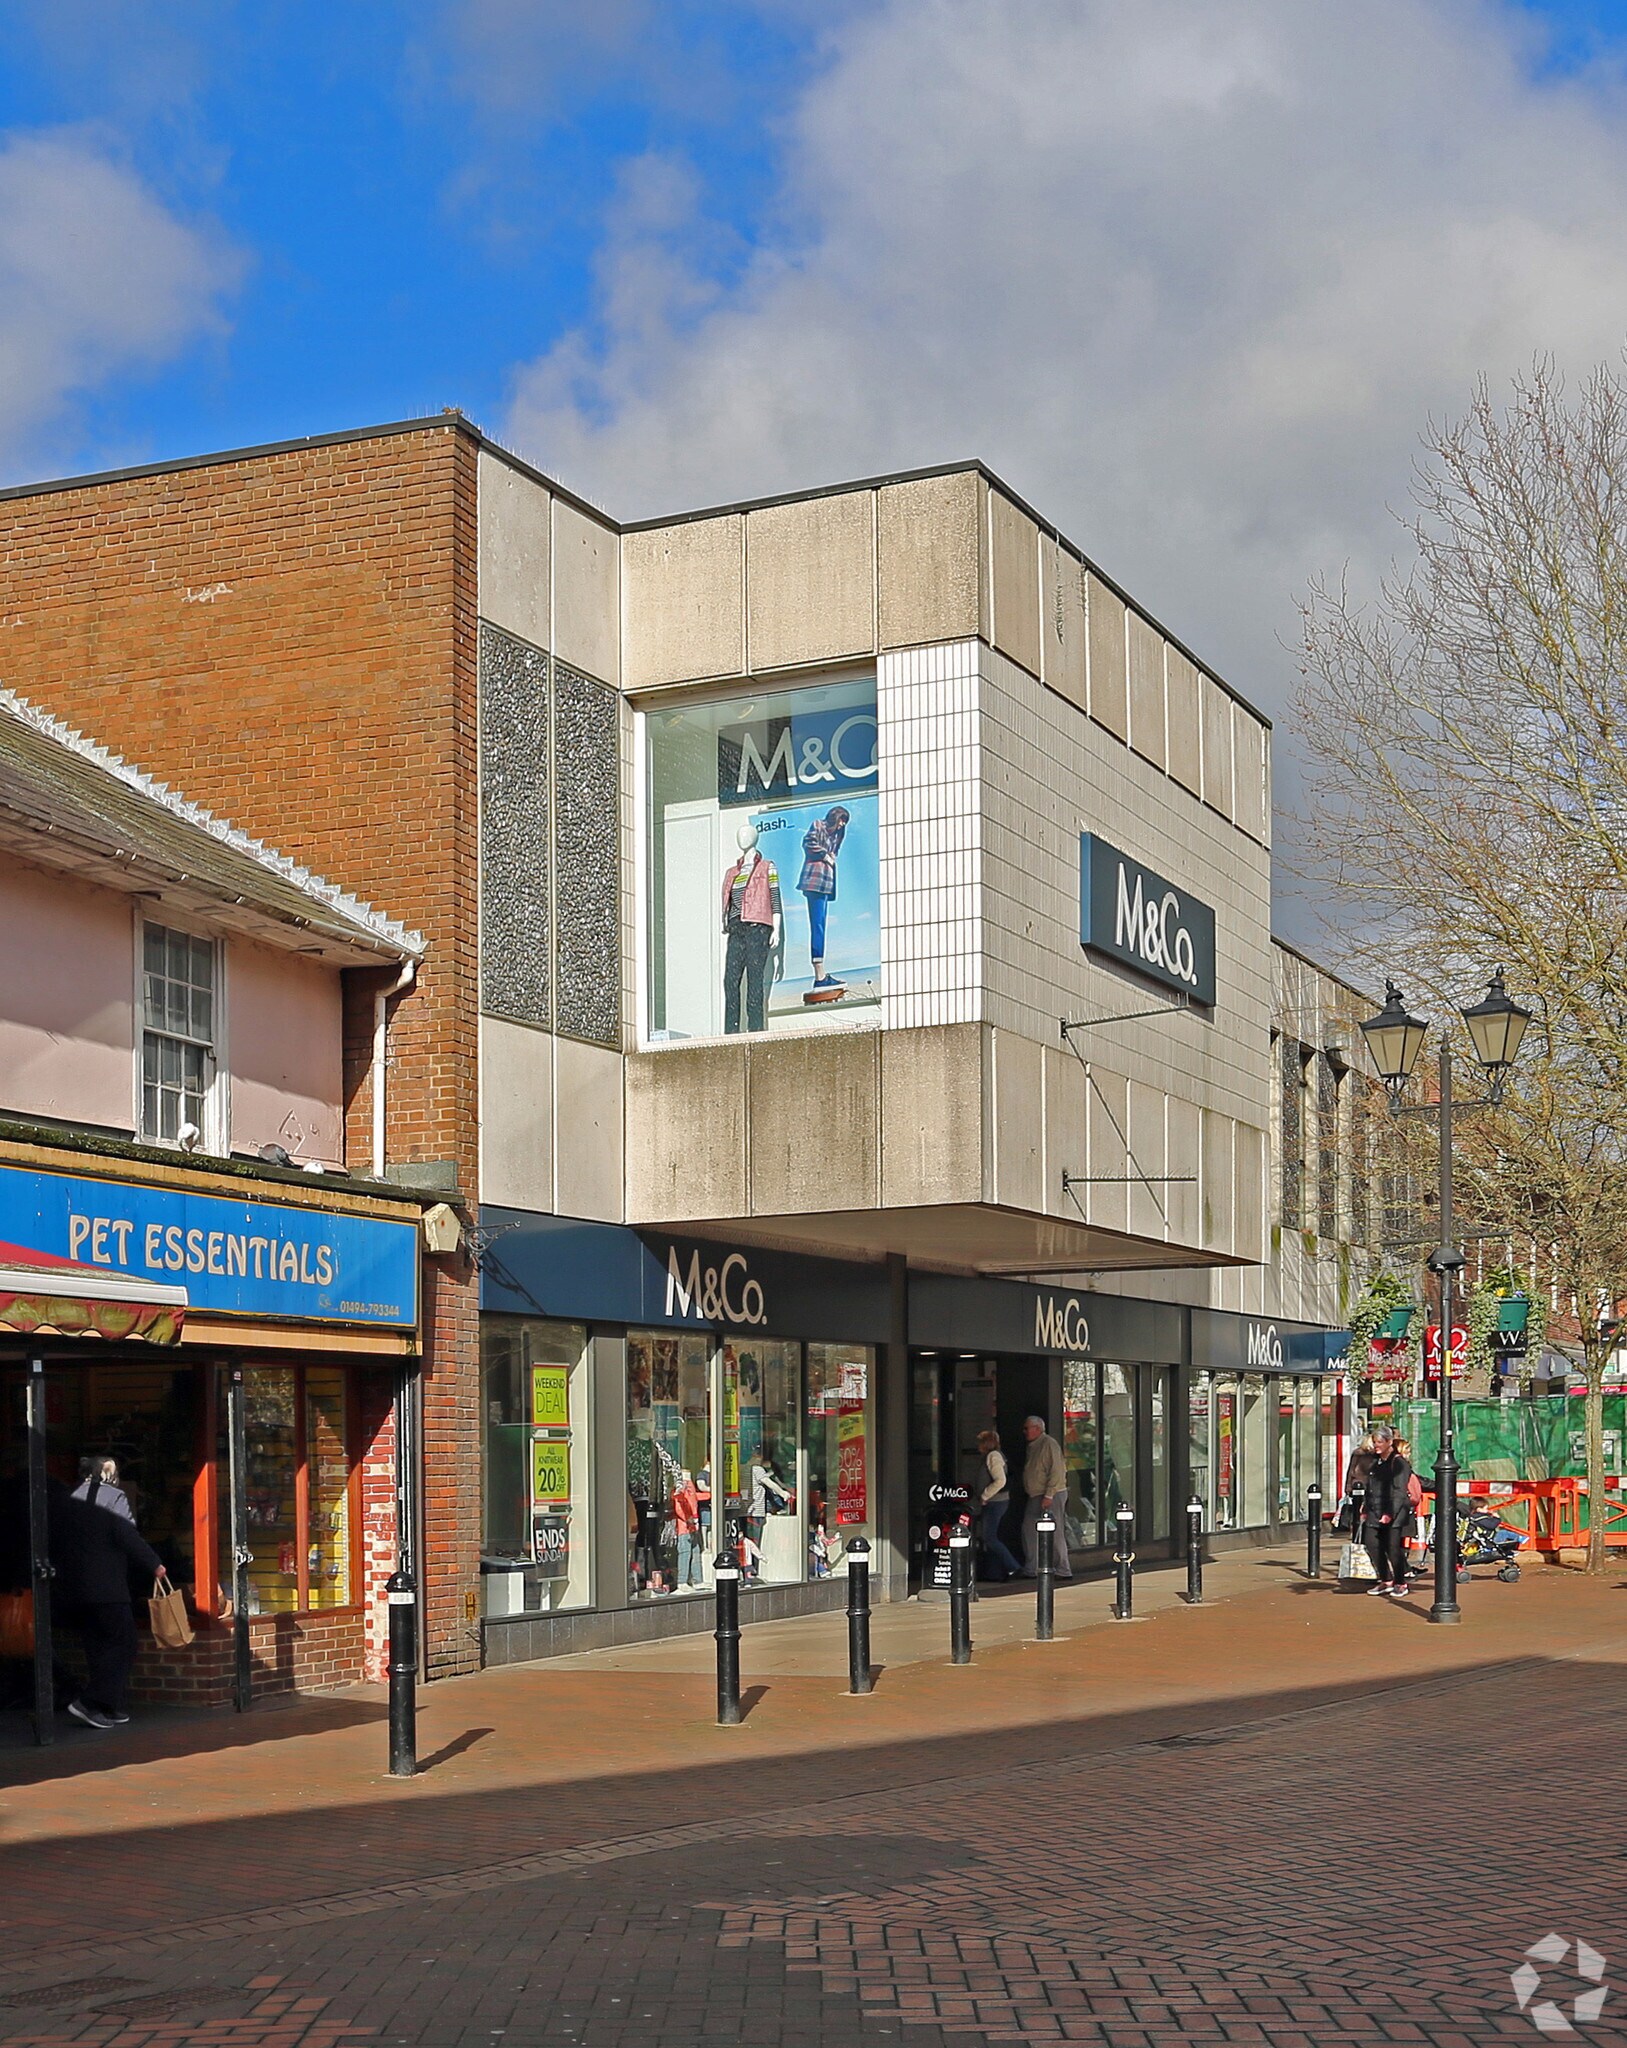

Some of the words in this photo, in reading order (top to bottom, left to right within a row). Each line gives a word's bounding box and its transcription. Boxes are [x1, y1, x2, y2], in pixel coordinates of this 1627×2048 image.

[1115, 861, 1198, 986] M&Co.
[69, 1214, 133, 1266] PET
[145, 1223, 334, 1286] ESSENTIALS
[665, 1245, 768, 1326] M&Co.
[340, 1300, 400, 1317] 01494-793344
[1035, 1295, 1090, 1352] M&Co.
[1247, 1322, 1283, 1367] M&Co.
[535, 1377, 566, 1389] WEEKEND
[536, 1391, 565, 1413] DEAL
[538, 1456, 564, 1465] KNITWEAR
[547, 1447, 556, 1455] ALL
[838, 1468, 862, 1492] OFF
[837, 1498, 864, 1510] SELECTED
[536, 1527, 566, 1550] ENDS
[536, 1548, 566, 1564] SUNDAY
